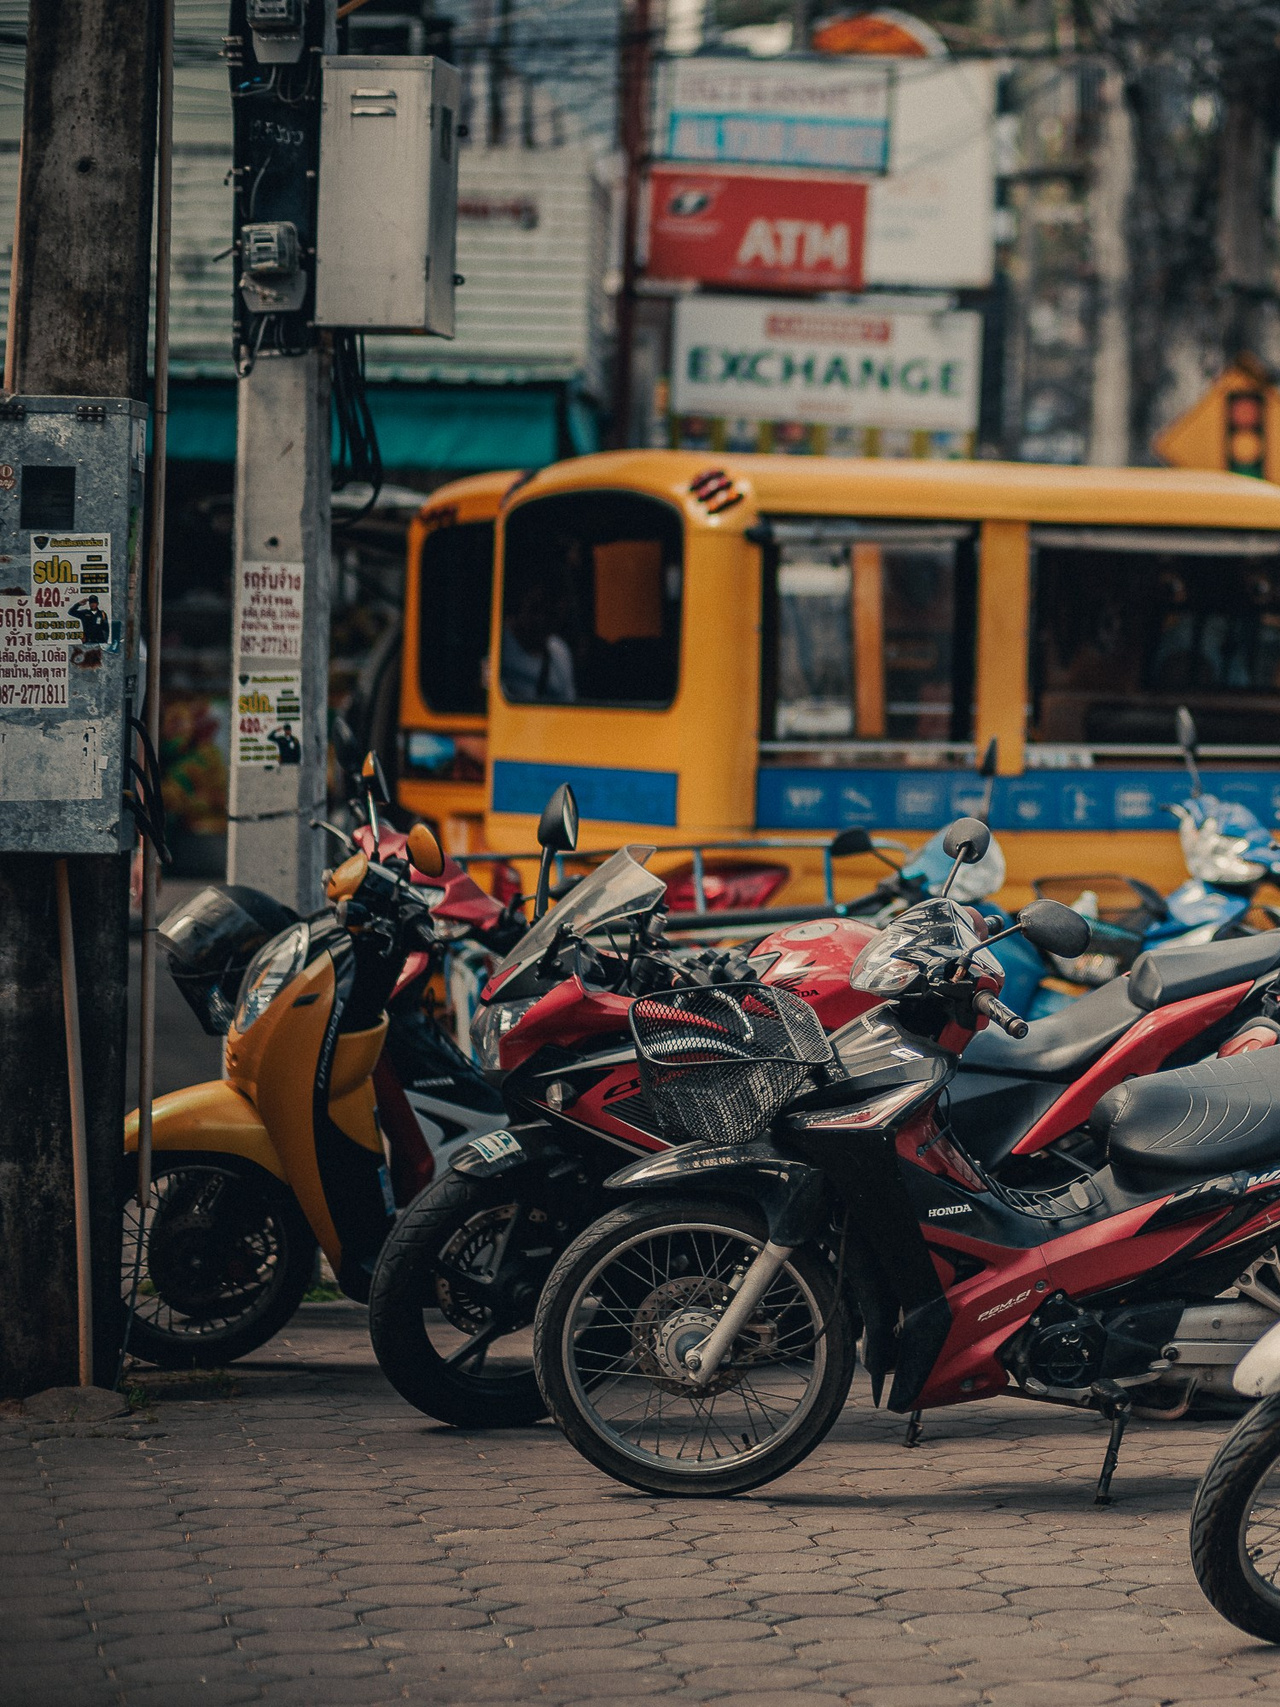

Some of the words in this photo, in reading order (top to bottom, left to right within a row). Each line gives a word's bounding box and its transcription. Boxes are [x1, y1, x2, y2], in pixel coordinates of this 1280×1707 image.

[737, 218, 850, 269] ATM
[687, 346, 964, 396] EXCHANGE
[0, 647, 67, 663] ล้อ,6ล้อ,10ล้อ
[0, 684, 66, 704] 87-2771811
[928, 1204, 972, 1217] HONDA
[977, 1289, 1031, 1320] PGM-FI
